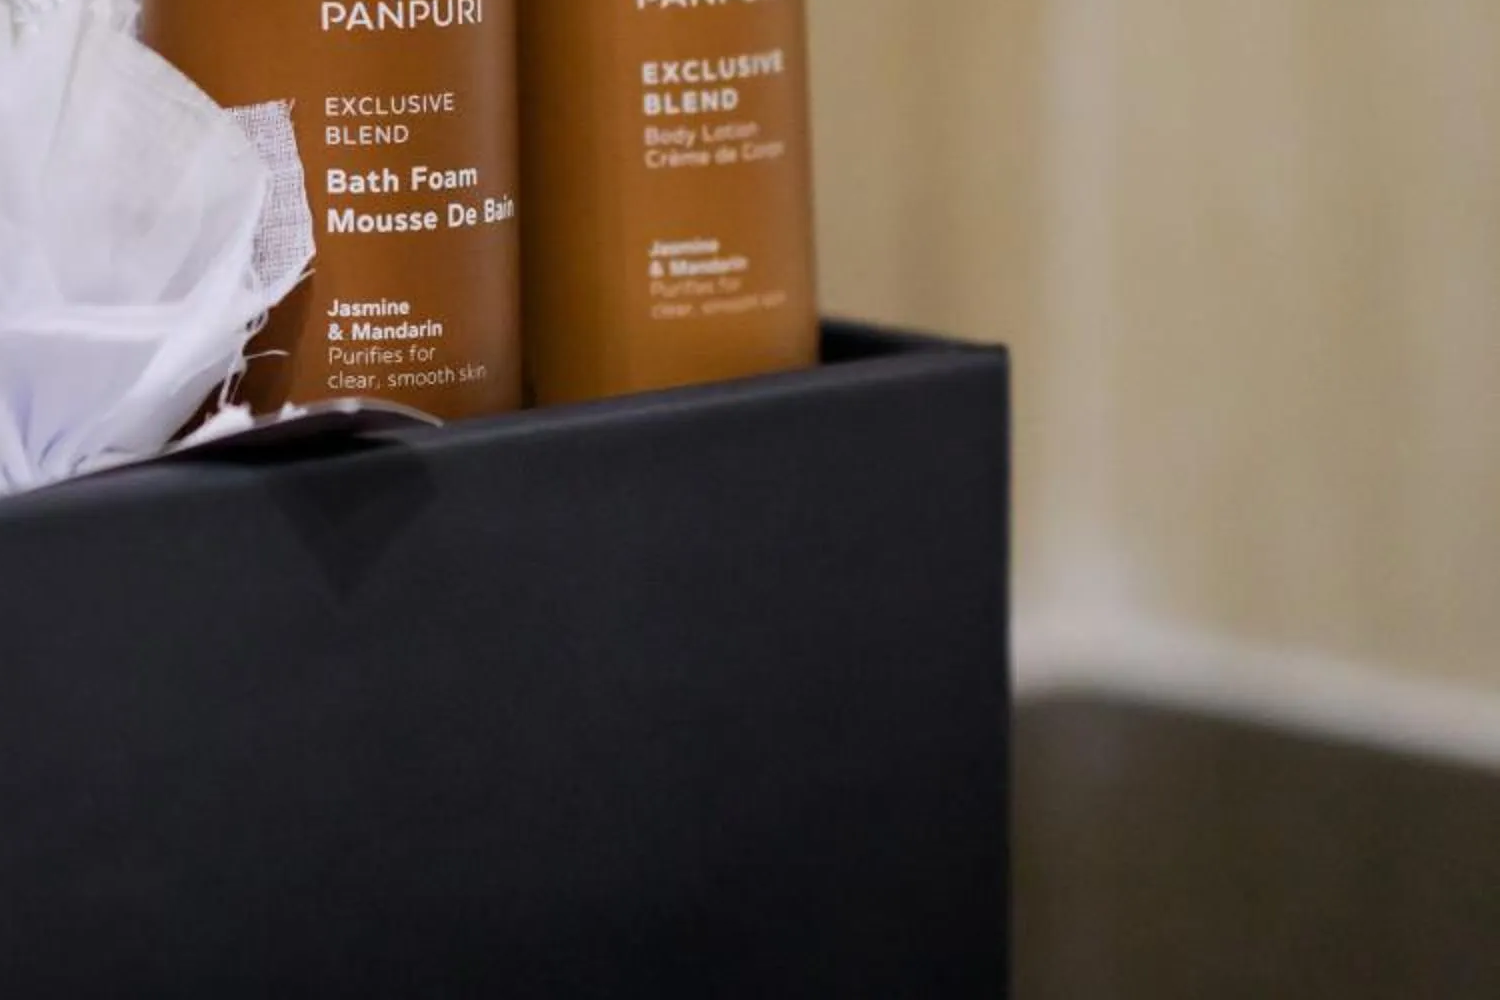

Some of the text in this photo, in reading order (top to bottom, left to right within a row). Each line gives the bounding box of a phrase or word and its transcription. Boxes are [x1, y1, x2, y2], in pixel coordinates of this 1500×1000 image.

[641, 50, 783, 85] EXCLUSIVE
[324, 93, 455, 117] EXCLUSIVE
[643, 88, 739, 116] BLEND
[325, 125, 409, 145] BLEND
[644, 124, 696, 148] Body
[326, 166, 478, 194] Bath Foam
[327, 194, 515, 233] Mousse De Bain
[327, 298, 411, 317] Jasmine
[328, 319, 443, 341] & Mandarin
[328, 344, 437, 366] Purifies for
[327, 371, 381, 390] clear,
[387, 366, 455, 388] smooth
